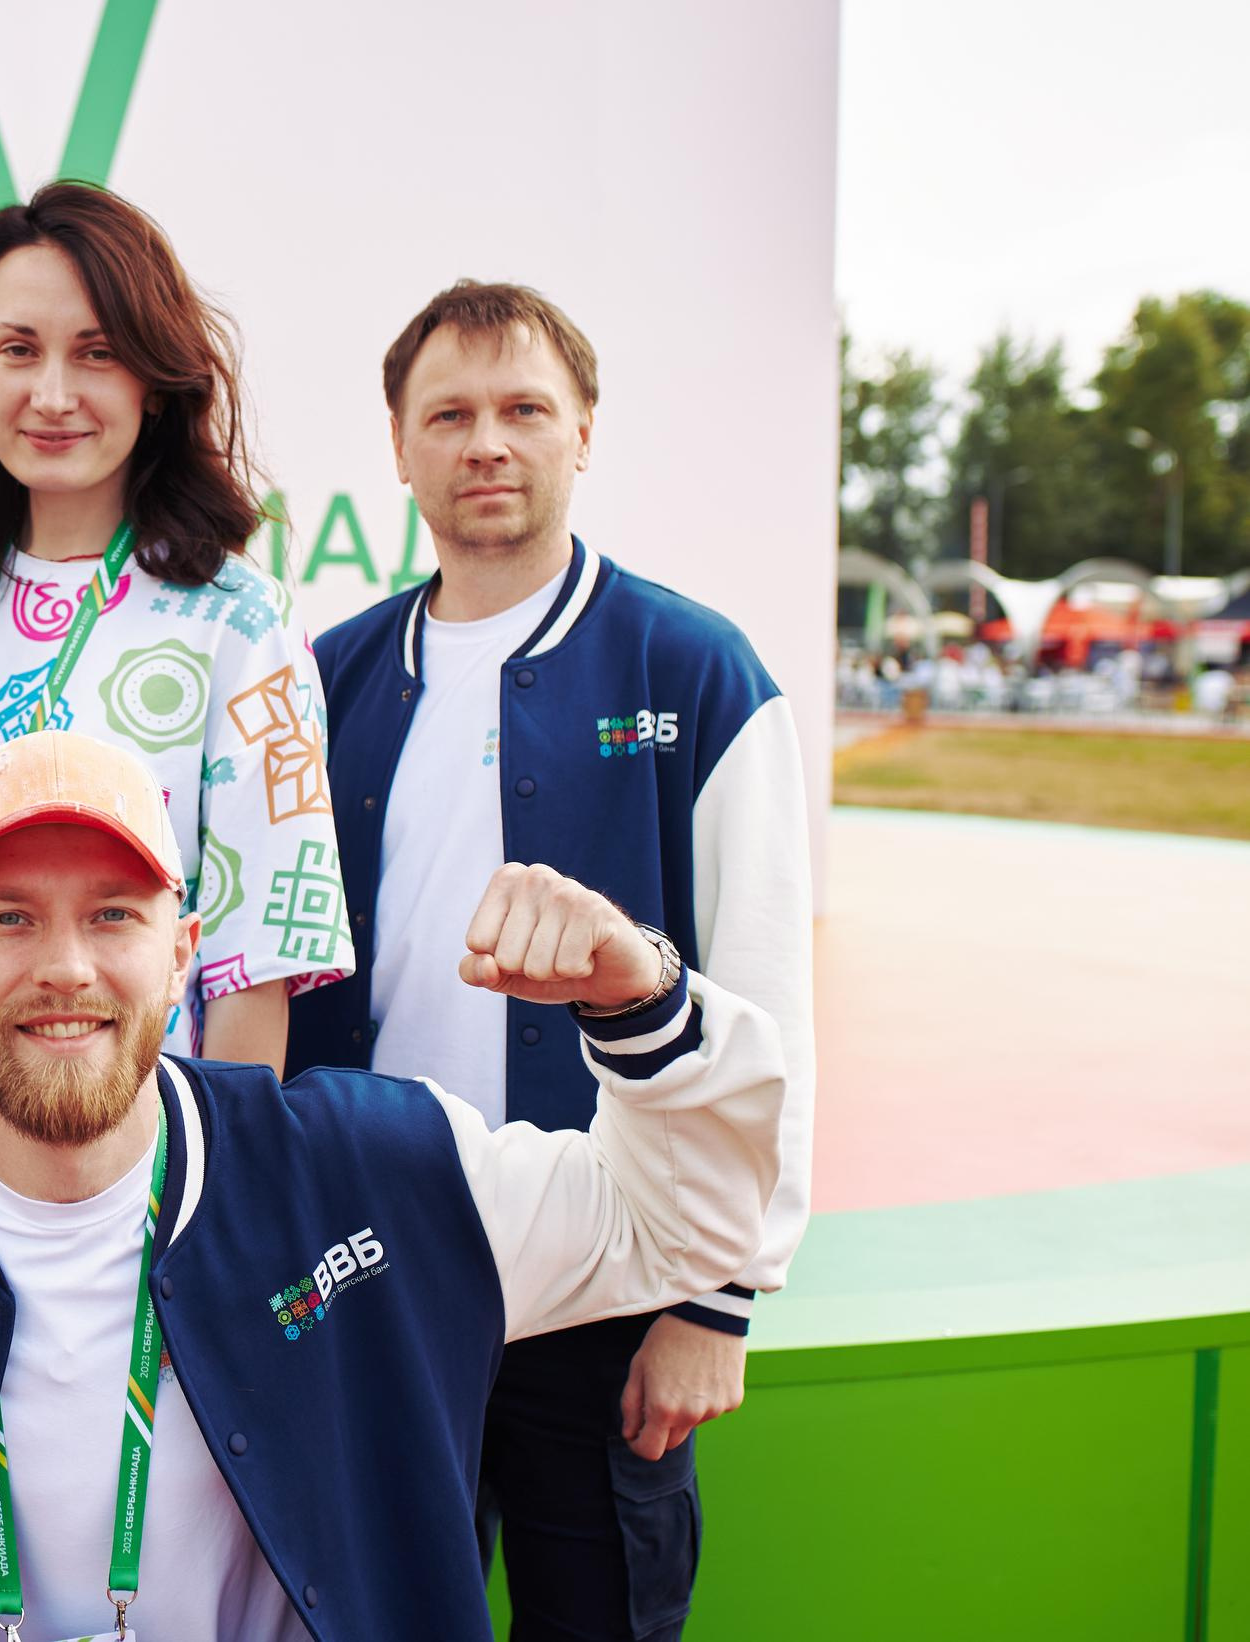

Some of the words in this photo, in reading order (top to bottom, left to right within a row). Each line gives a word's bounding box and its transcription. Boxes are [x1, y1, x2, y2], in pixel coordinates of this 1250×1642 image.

[312, 1226, 384, 1303] ВВБ
[371, 1261, 391, 1277] банк
[140, 1355, 151, 1379] 2023
[124, 1445, 142, 1530] СБЕРБАНКИАДА
[122, 1531, 134, 1555] 2023
